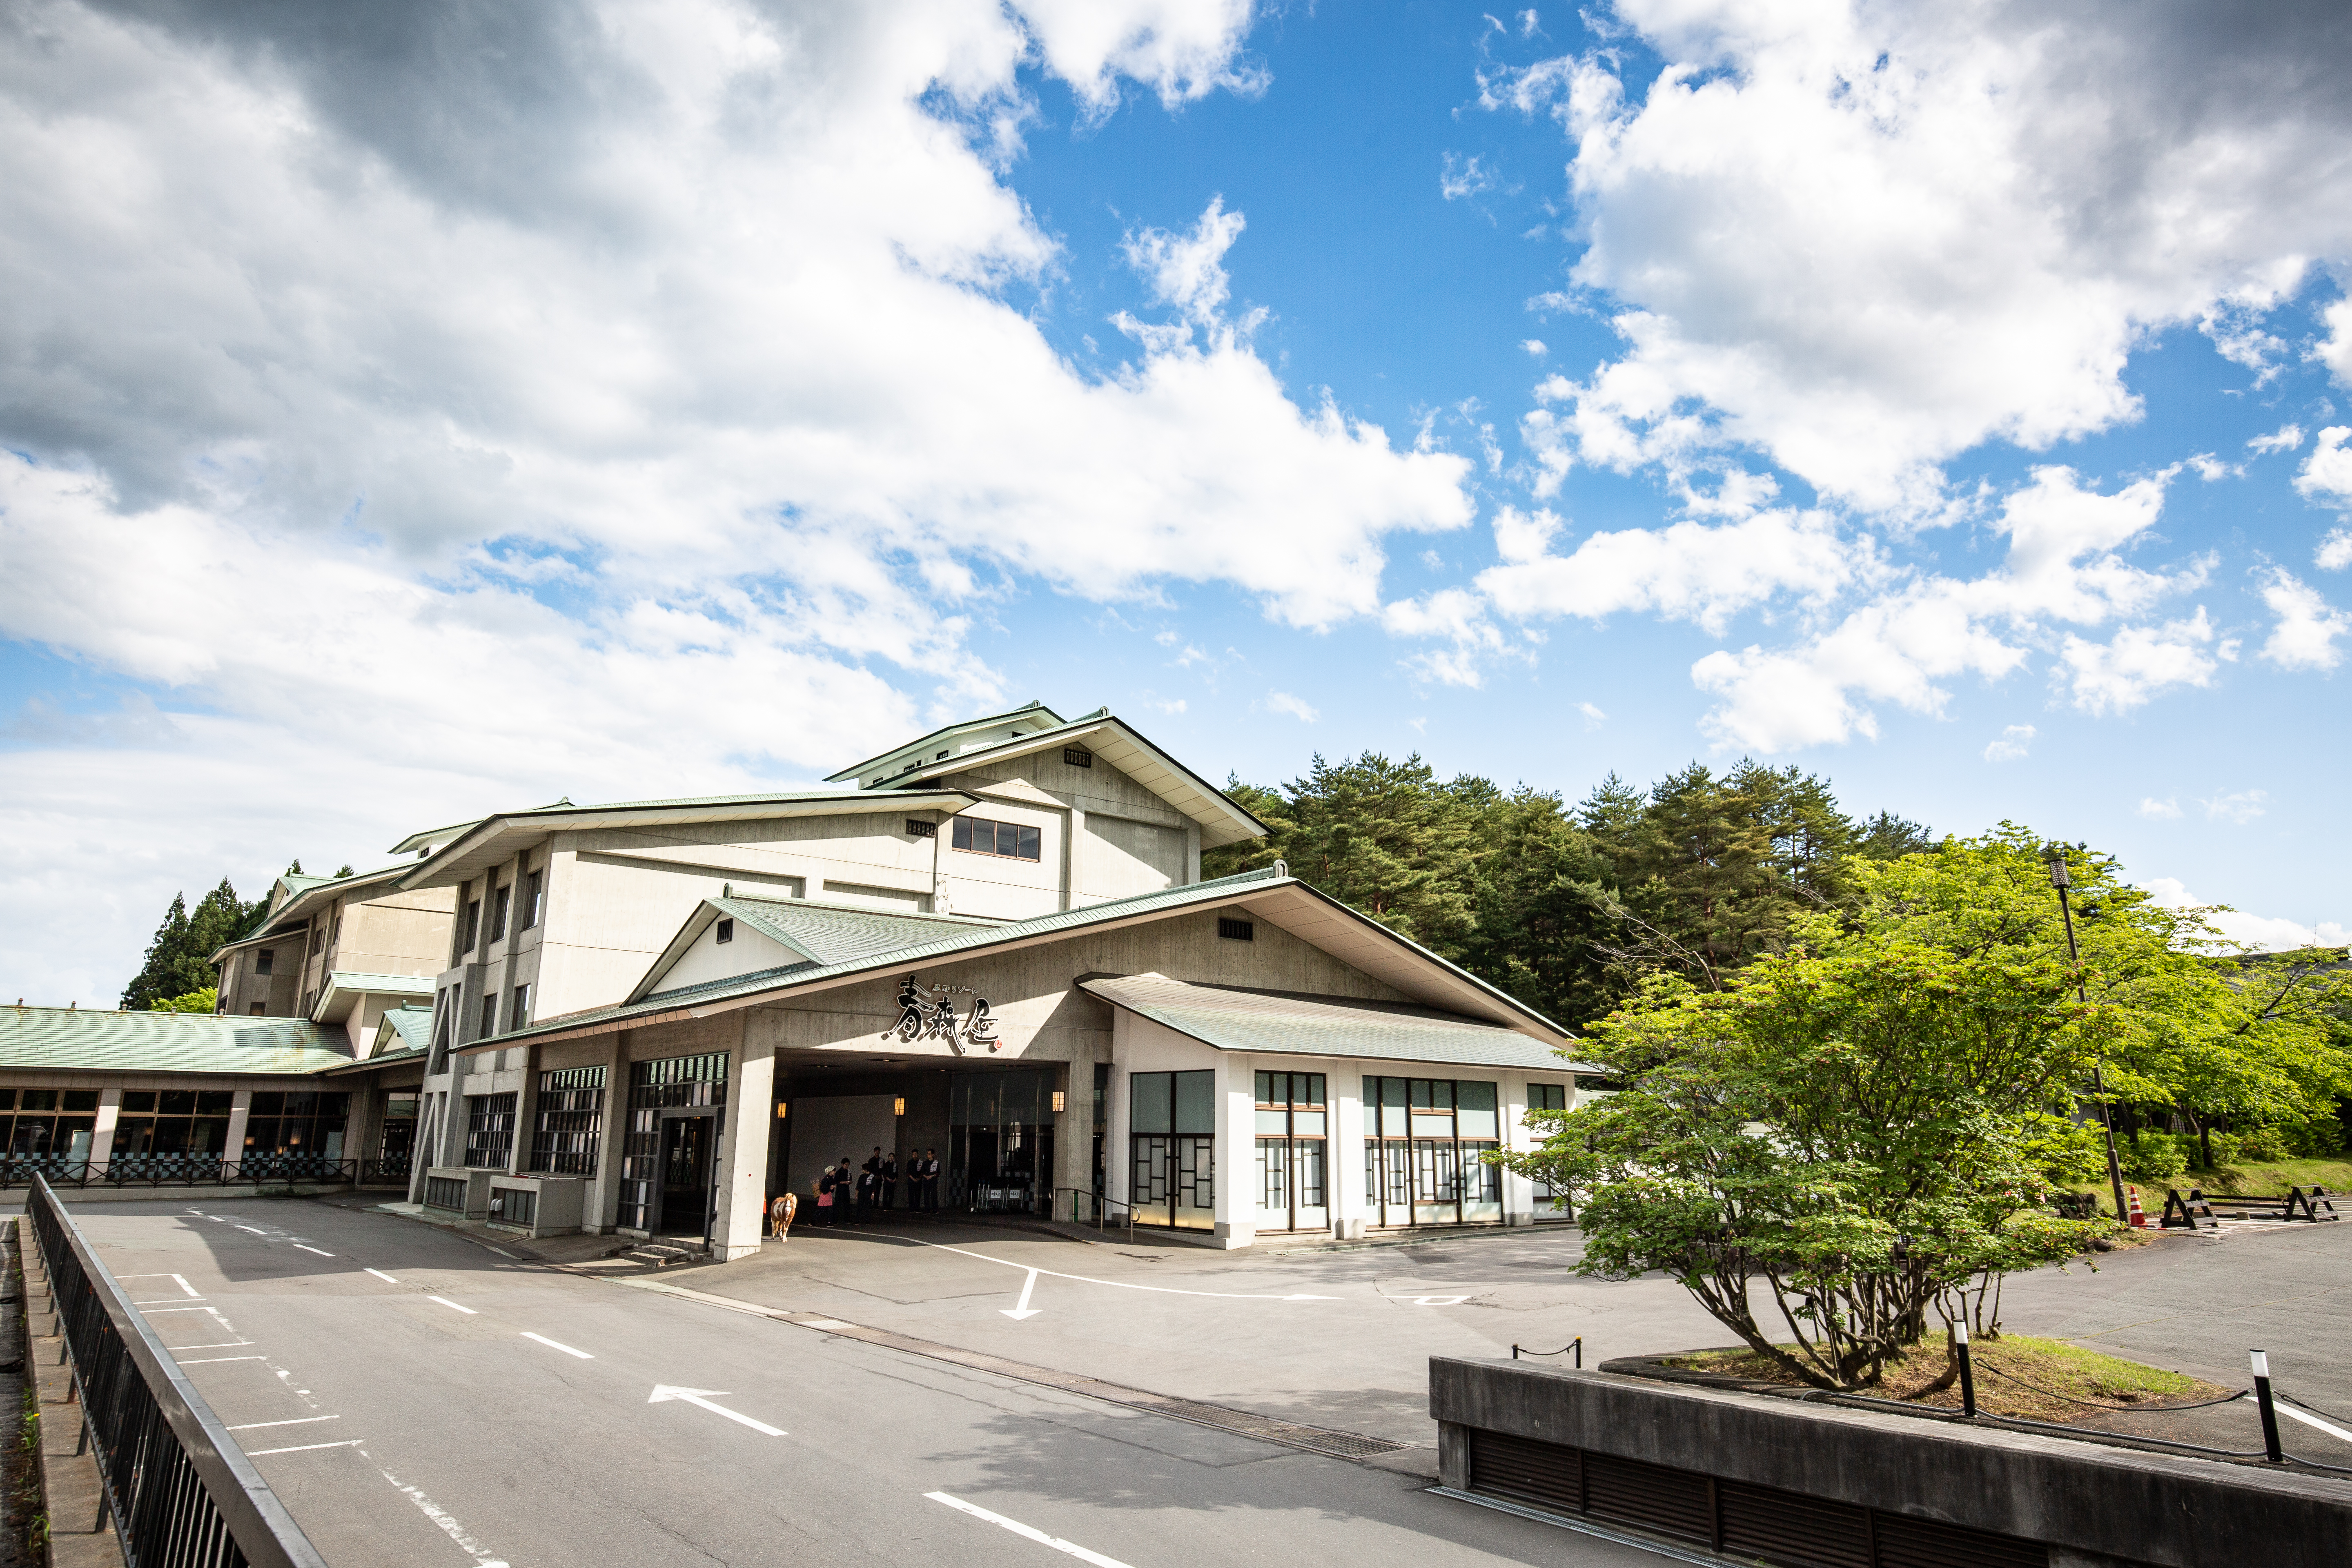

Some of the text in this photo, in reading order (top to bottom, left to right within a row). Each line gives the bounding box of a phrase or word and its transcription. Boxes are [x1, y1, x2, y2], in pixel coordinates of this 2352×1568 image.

[932, 984, 978, 994] 星野リゾート
